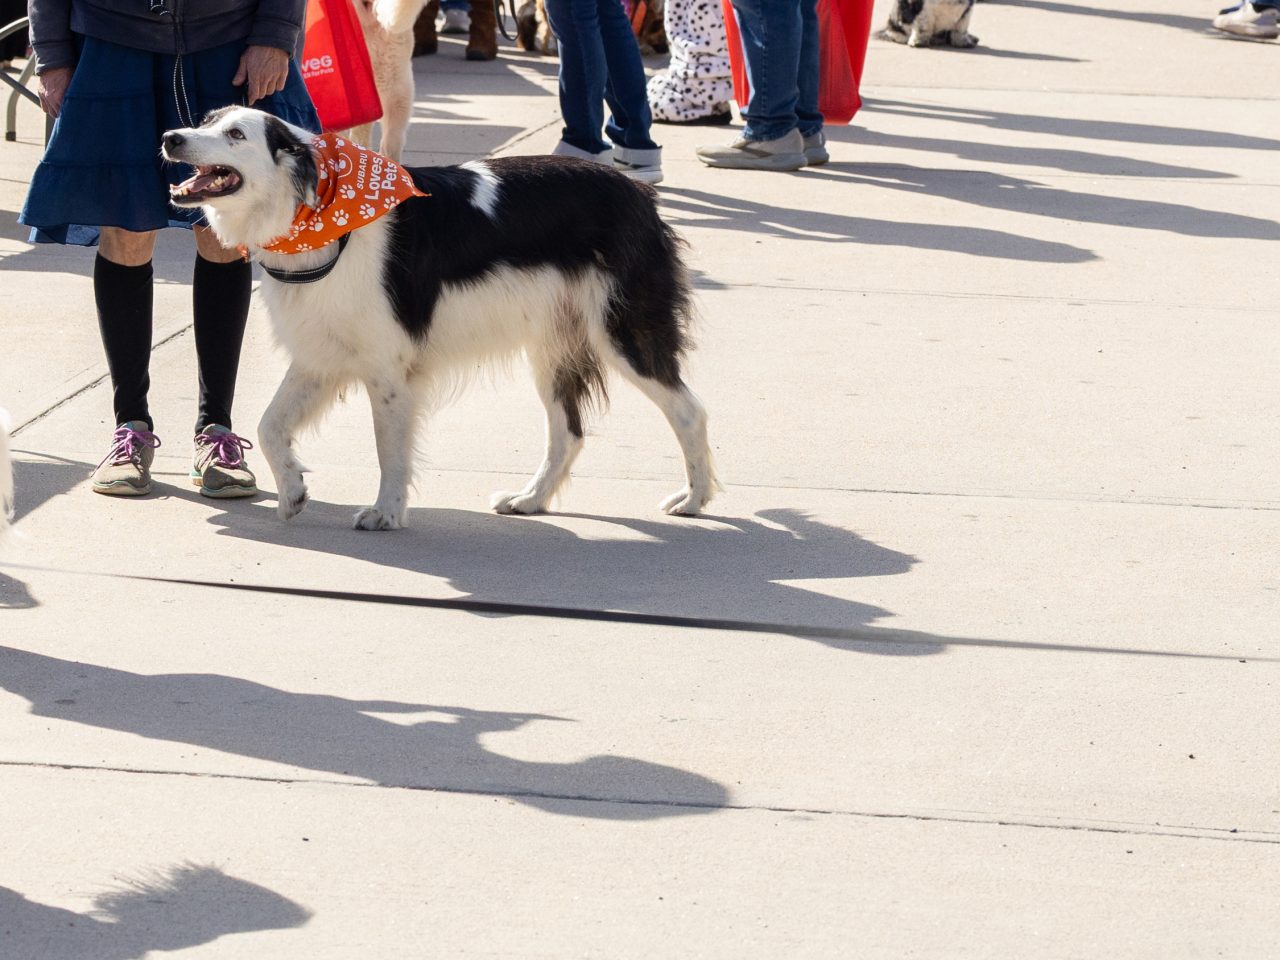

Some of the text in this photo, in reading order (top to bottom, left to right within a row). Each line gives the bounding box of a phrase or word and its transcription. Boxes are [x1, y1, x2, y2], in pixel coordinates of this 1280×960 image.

[356, 152, 369, 190] SUBARU
[365, 156, 384, 201] Loves
[381, 161, 398, 191] Pets
